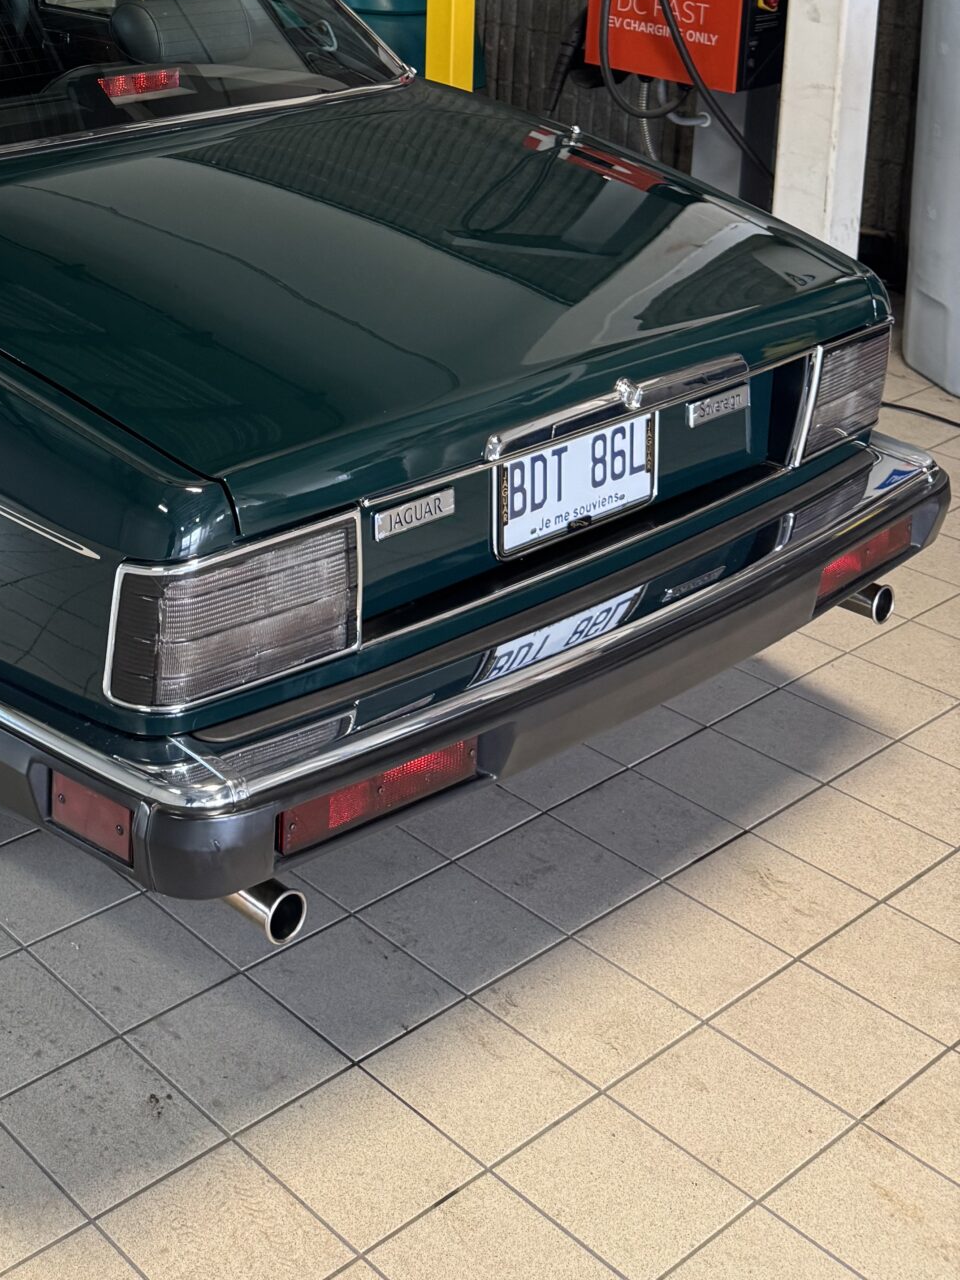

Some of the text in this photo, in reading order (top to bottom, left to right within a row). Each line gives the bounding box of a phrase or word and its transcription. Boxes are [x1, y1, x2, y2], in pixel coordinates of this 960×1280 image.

[608, 15, 622, 28] EV
[686, 30, 718, 46] ONLY
[509, 422, 646, 520] BDT 86L
[388, 497, 443, 532] JAGUAR
[538, 491, 620, 531] Je me souviens
